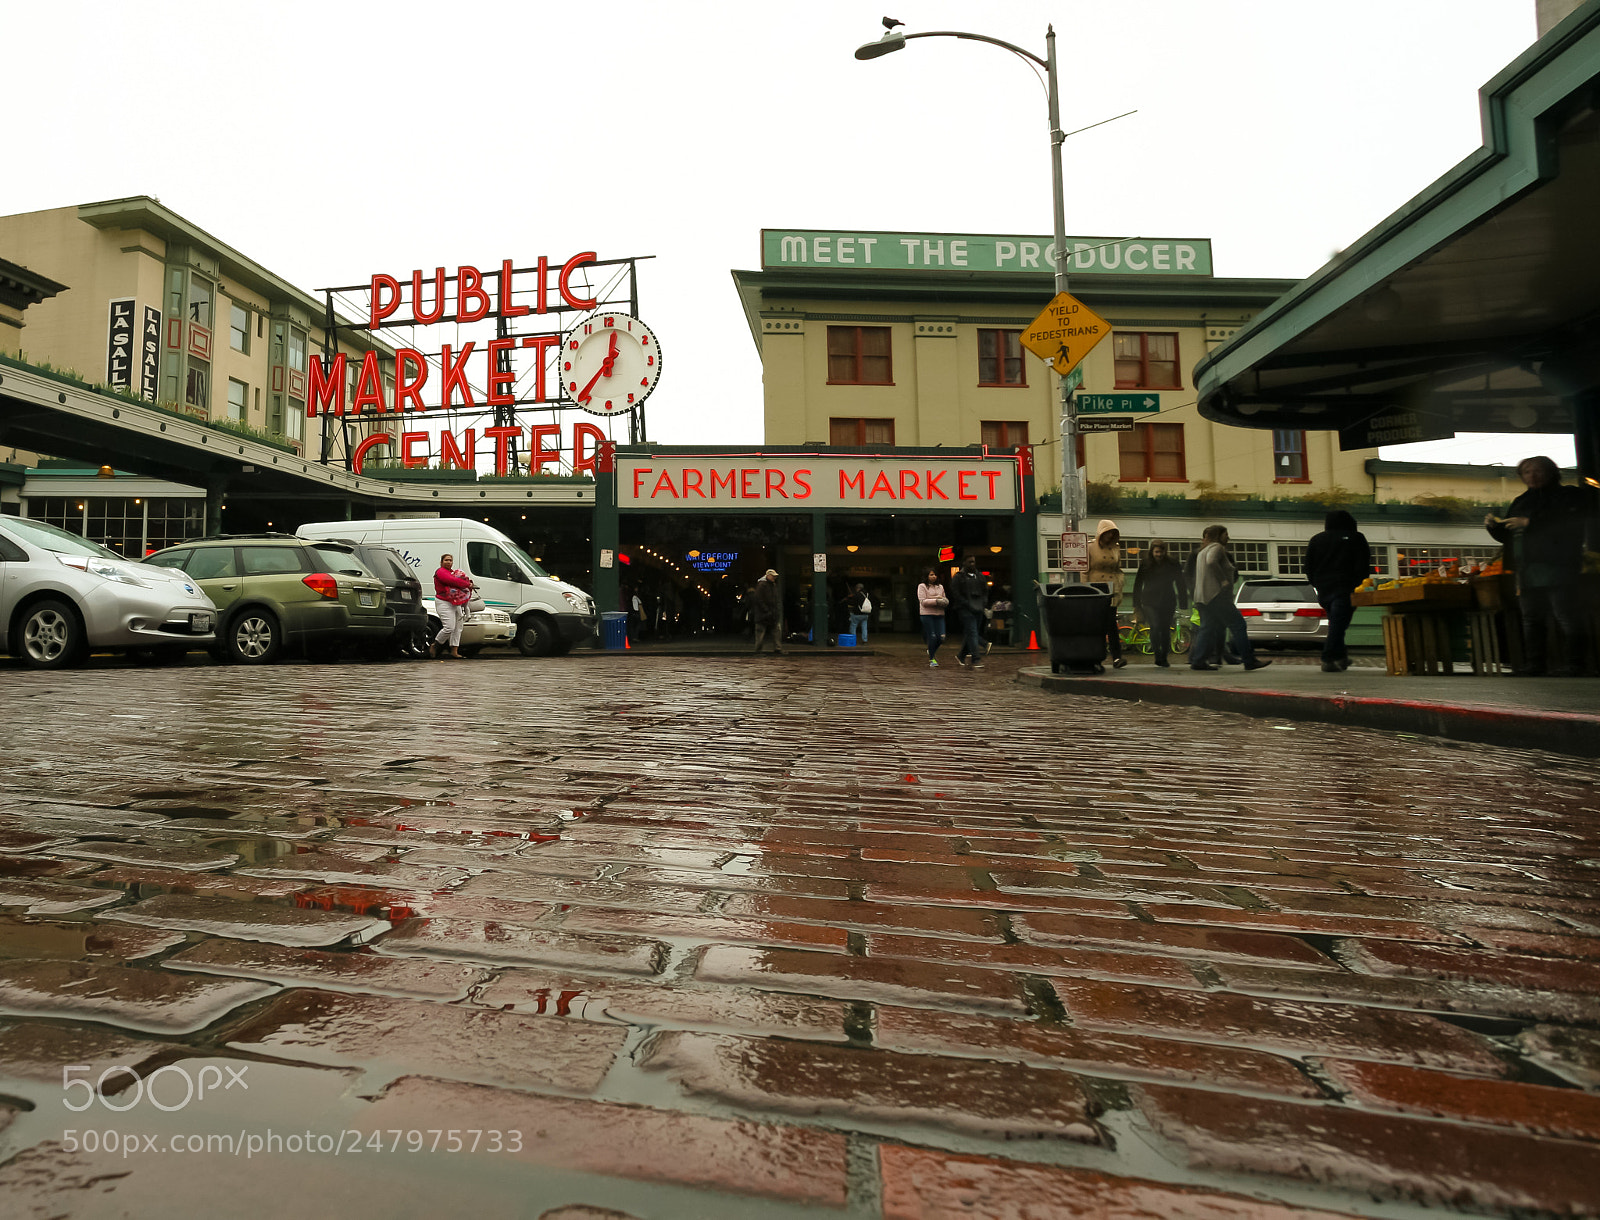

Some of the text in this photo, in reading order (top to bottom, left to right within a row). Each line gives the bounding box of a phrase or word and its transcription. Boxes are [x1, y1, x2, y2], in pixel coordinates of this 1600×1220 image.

[780, 235, 1196, 270] MEET THE PRODUCER
[370, 251, 597, 330] PUBLIC
[1049, 305, 1079, 316] YIELD
[604, 317, 614, 328] 12
[1058, 318, 1070, 327] TO
[1030, 325, 1099, 342] PEDESTRIANS
[569, 340, 579, 350] 10
[307, 336, 561, 418] MARKET
[1081, 396, 1114, 410] Pike
[1370, 413, 1417, 429] CORNER
[1367, 427, 1422, 443] PRODUCE
[353, 423, 607, 480] CENTER
[633, 468, 1002, 501] FARMERS MARKET
